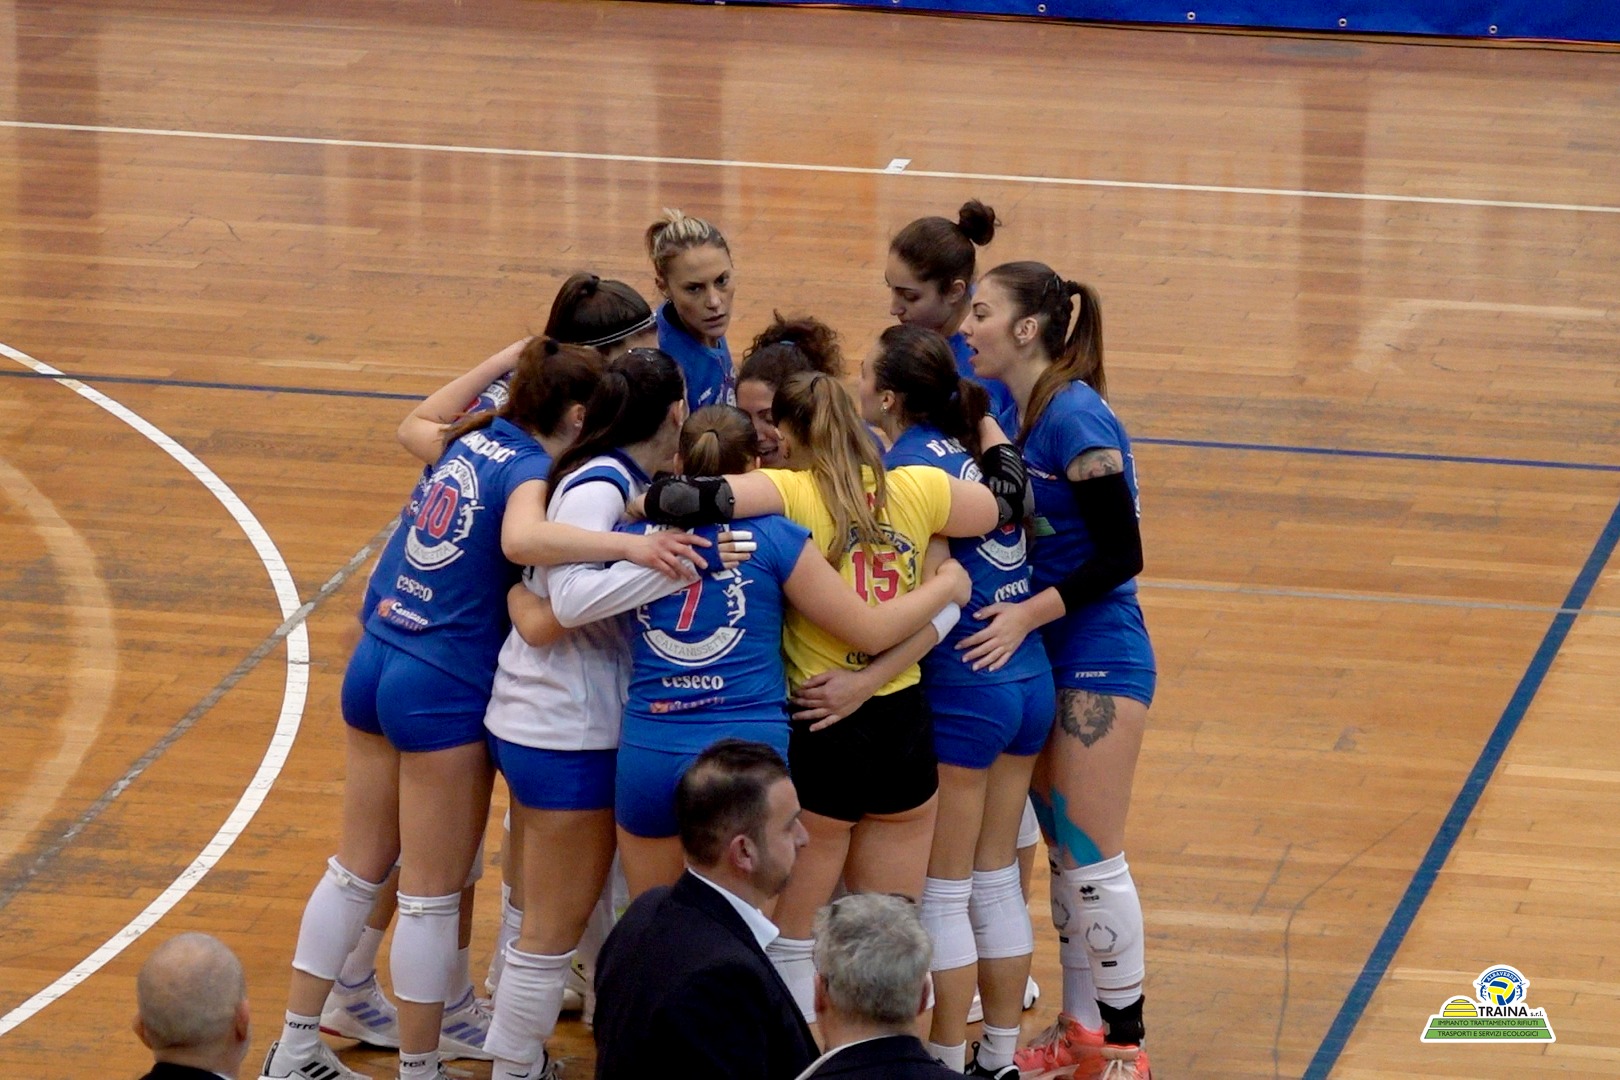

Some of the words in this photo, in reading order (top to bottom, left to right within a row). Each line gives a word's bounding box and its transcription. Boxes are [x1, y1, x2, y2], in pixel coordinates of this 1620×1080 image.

[416, 481, 459, 539] 10
[852, 551, 900, 603] 15
[669, 577, 703, 632] 7
[654, 630, 731, 657] CALTANISSETTA
